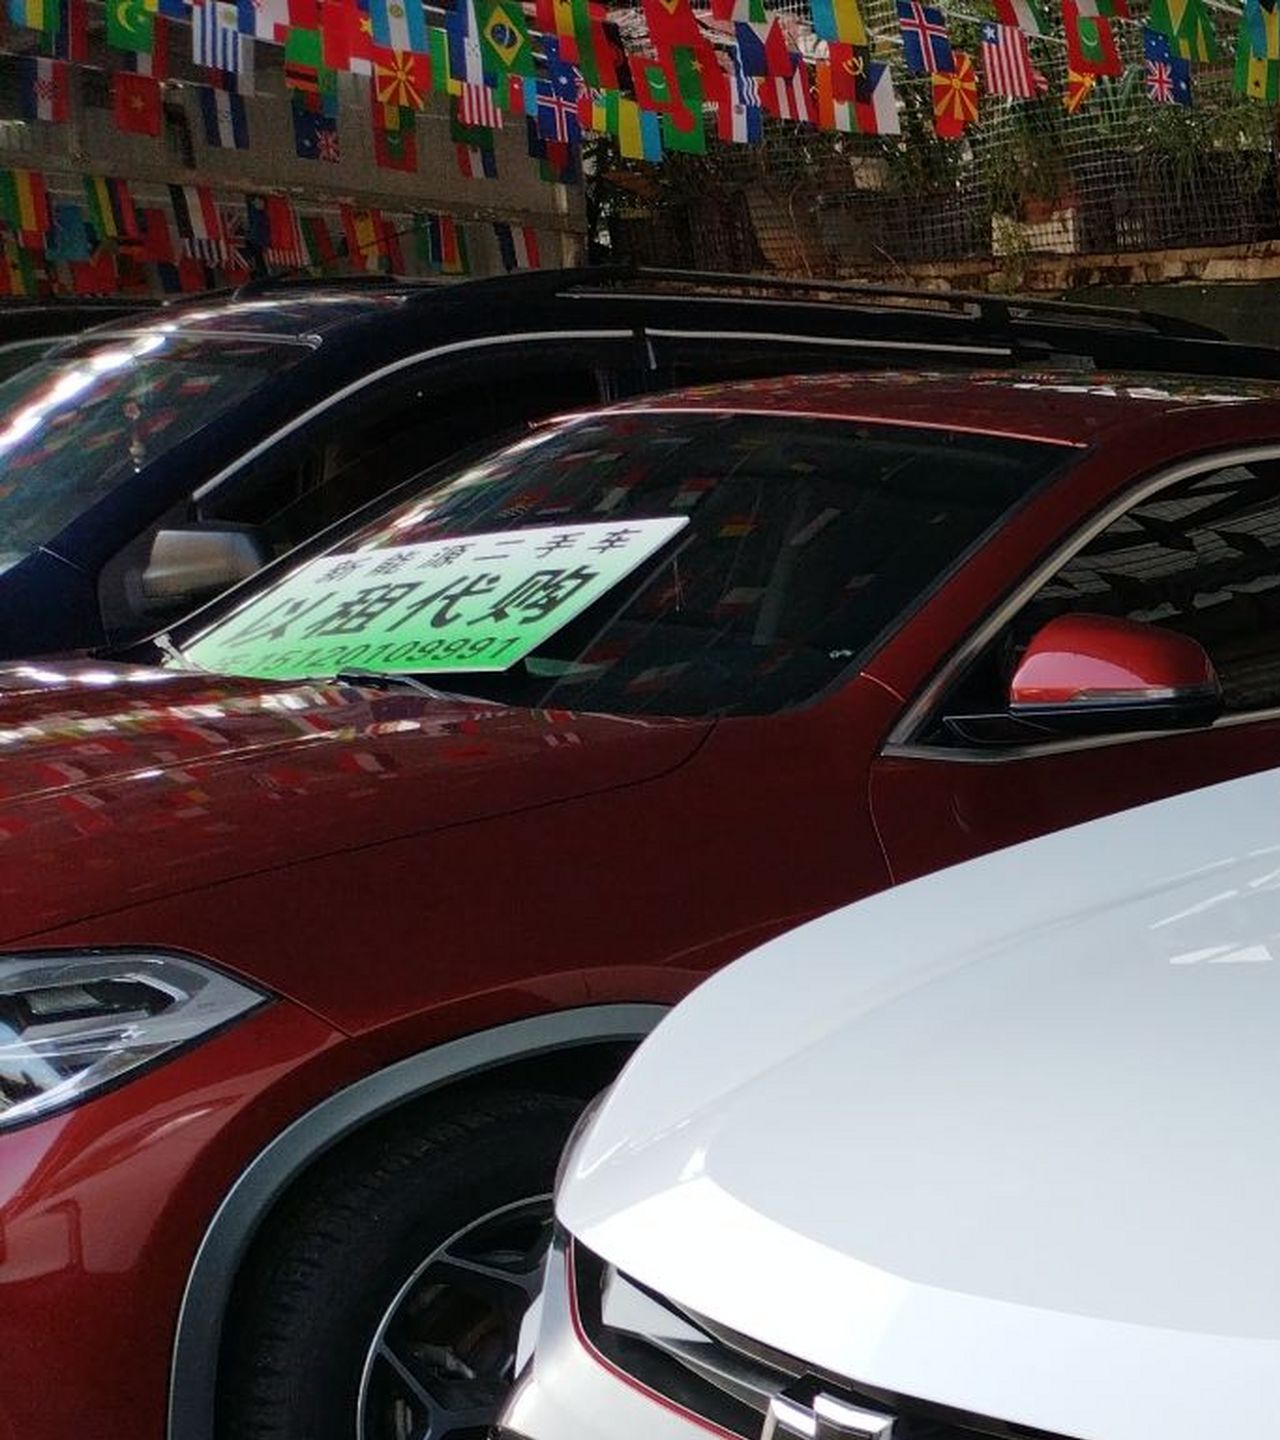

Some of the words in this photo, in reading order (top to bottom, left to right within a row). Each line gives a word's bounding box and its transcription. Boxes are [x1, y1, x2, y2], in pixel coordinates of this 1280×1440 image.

[314, 527, 643, 584] 新能源二手车
[221, 563, 600, 646] 以租代购
